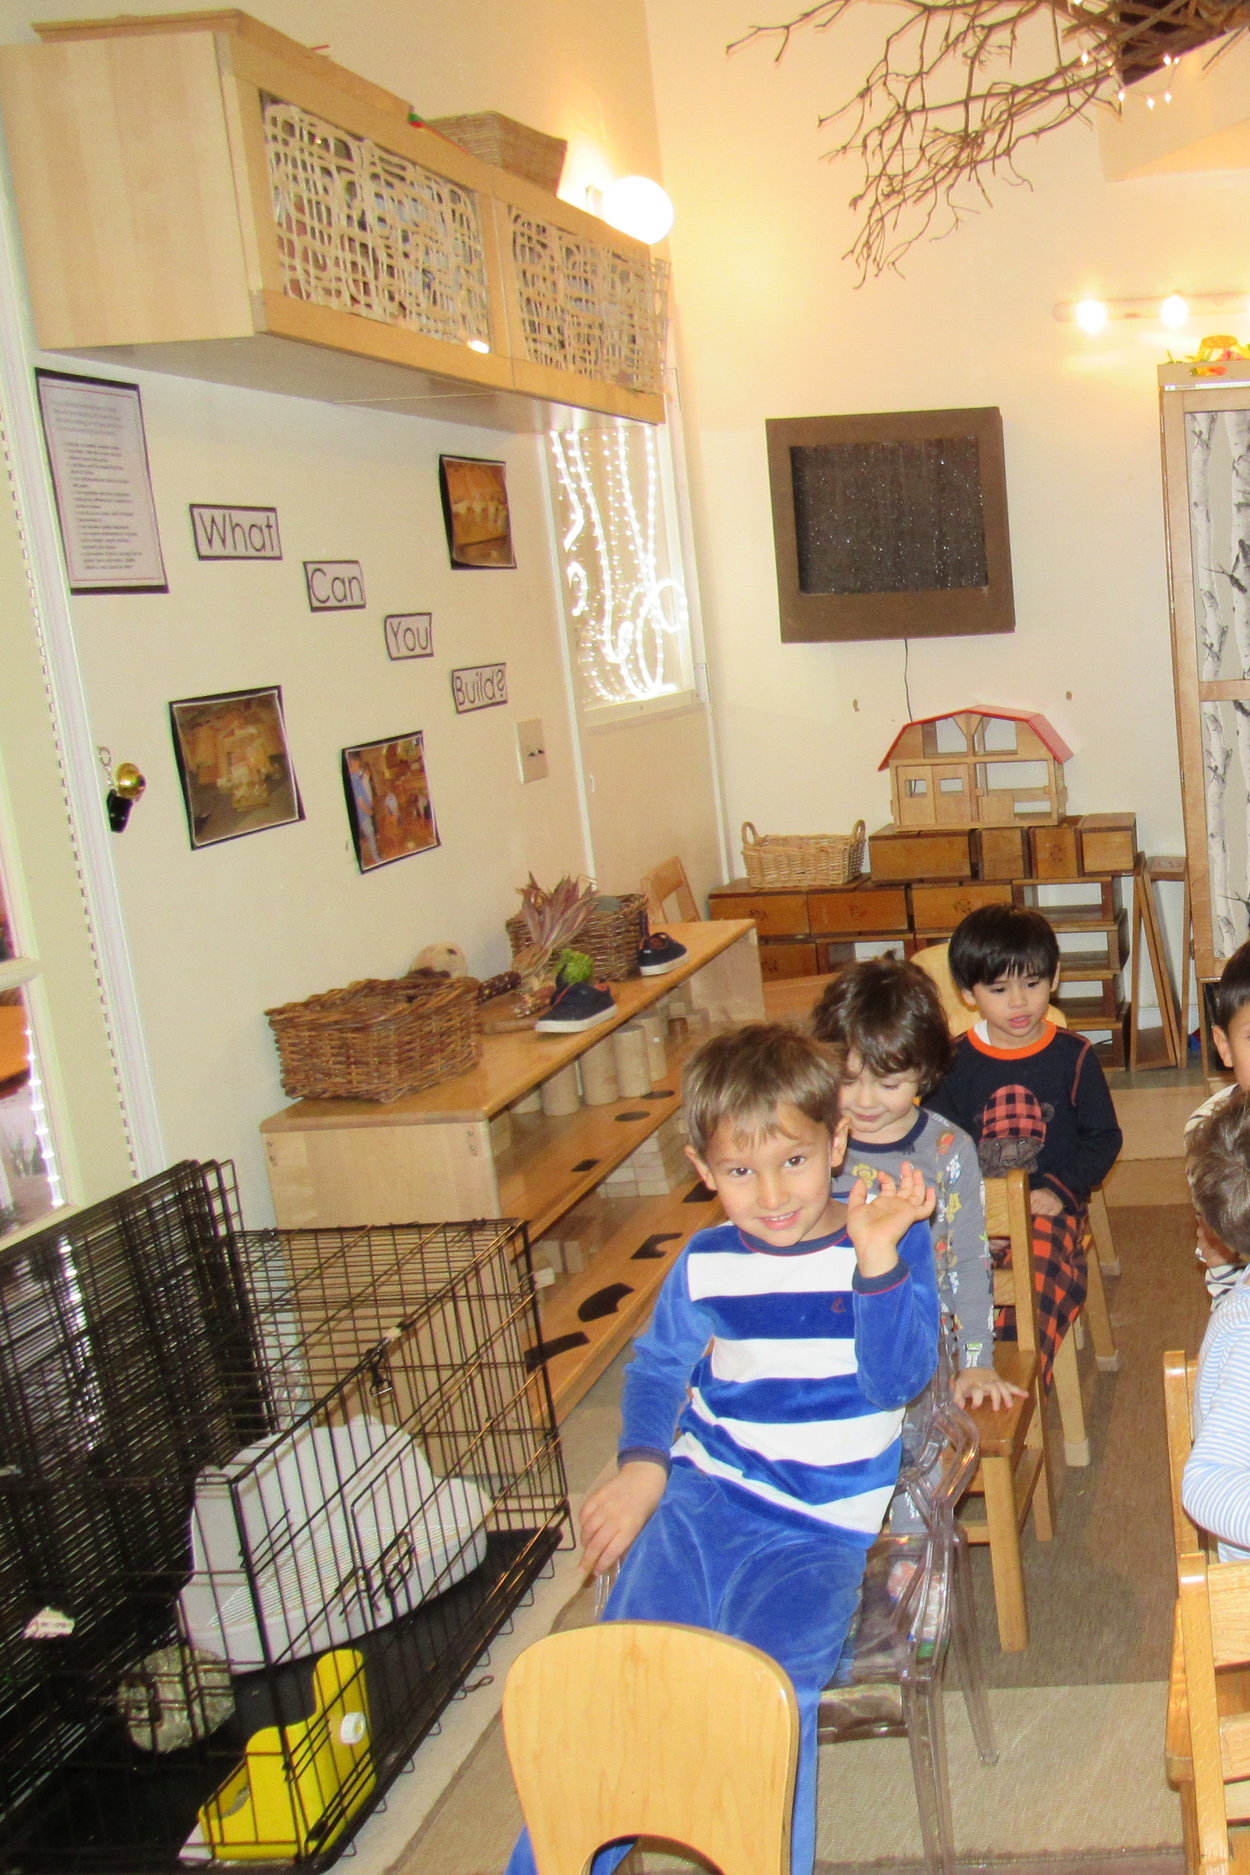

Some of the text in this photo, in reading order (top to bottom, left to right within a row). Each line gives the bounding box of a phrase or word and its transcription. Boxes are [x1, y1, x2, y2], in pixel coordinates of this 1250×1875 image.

[198, 511, 275, 552] What
[310, 567, 364, 604] Can
[389, 620, 429, 653] You
[455, 669, 505, 706] Build?
